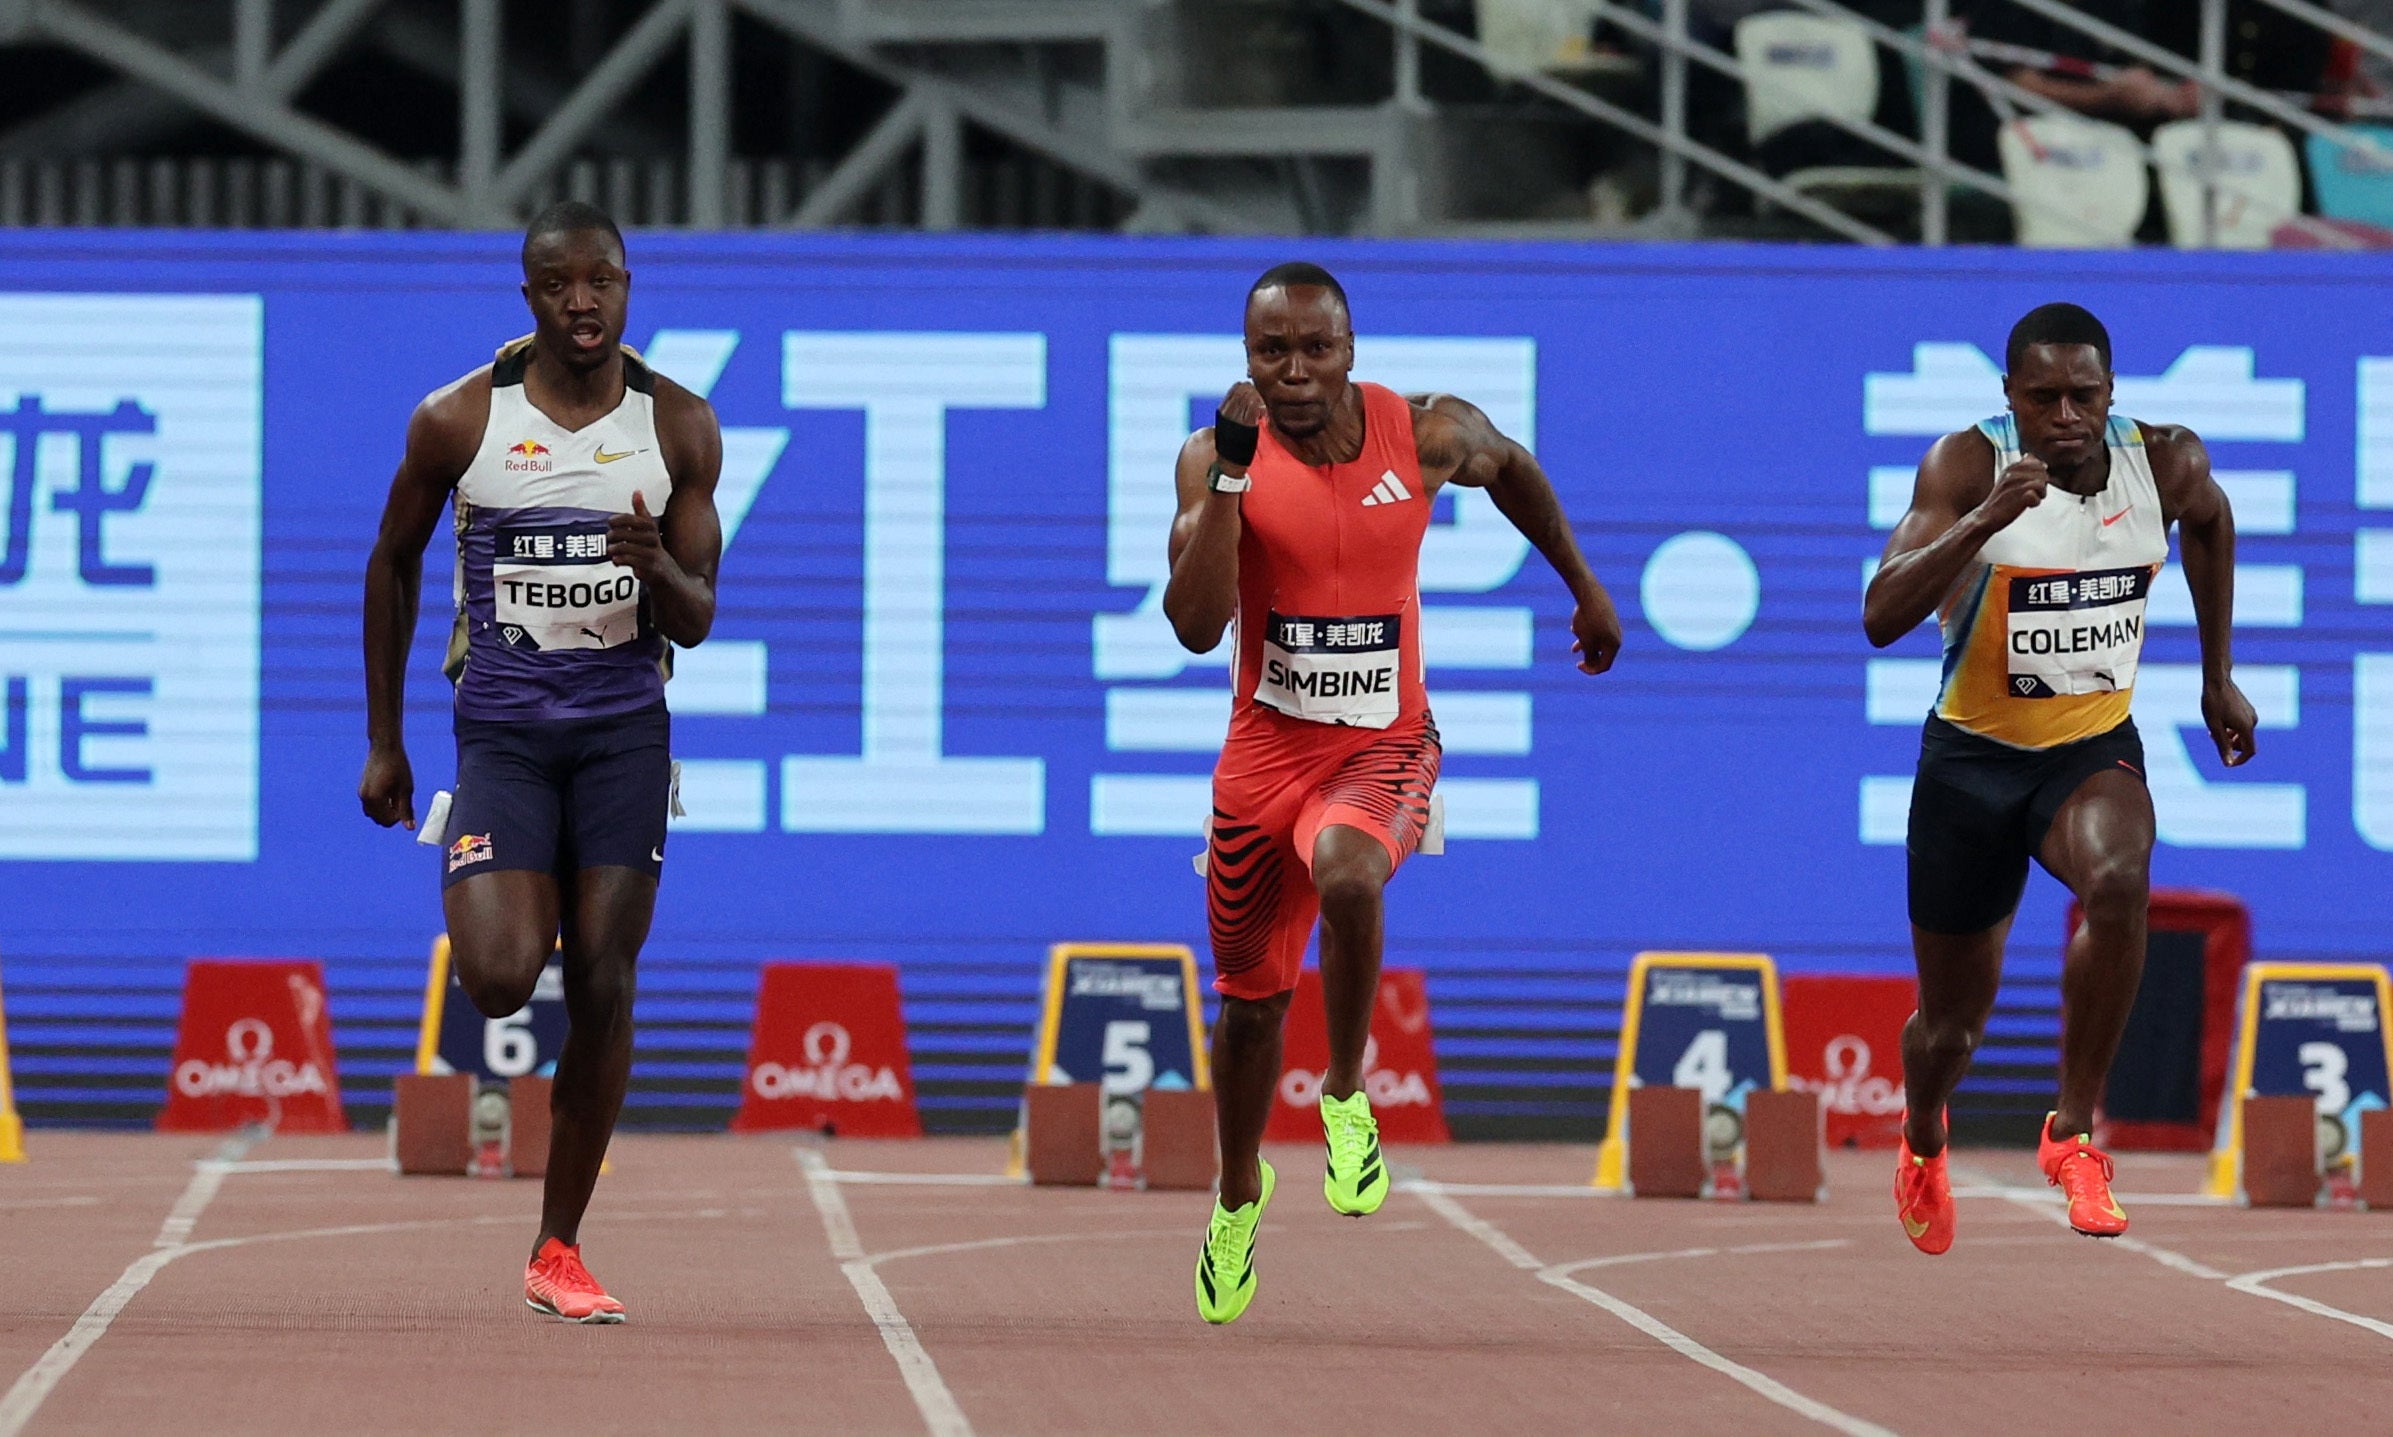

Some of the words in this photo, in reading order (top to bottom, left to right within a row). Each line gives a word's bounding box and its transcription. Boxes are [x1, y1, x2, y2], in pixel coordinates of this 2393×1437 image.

[505, 459, 528, 471] Red
[530, 460, 552, 472] Bull
[513, 534, 608, 558] 红星·美凯
[502, 575, 635, 608] TEBOGO
[2028, 574, 2136, 605] 红星·美凯龙
[2012, 615, 2141, 655] COLEMAN
[1267, 659, 1393, 698] SIMBINE
[484, 1004, 538, 1077] 6
[1101, 1020, 1155, 1095] 5
[176, 1059, 328, 1098] OMEGA
[752, 1062, 904, 1102] OMEGA
[1673, 1030, 1733, 1104] 4
[2298, 1041, 2351, 1115] 3
[1279, 1068, 1432, 1108] OGA
